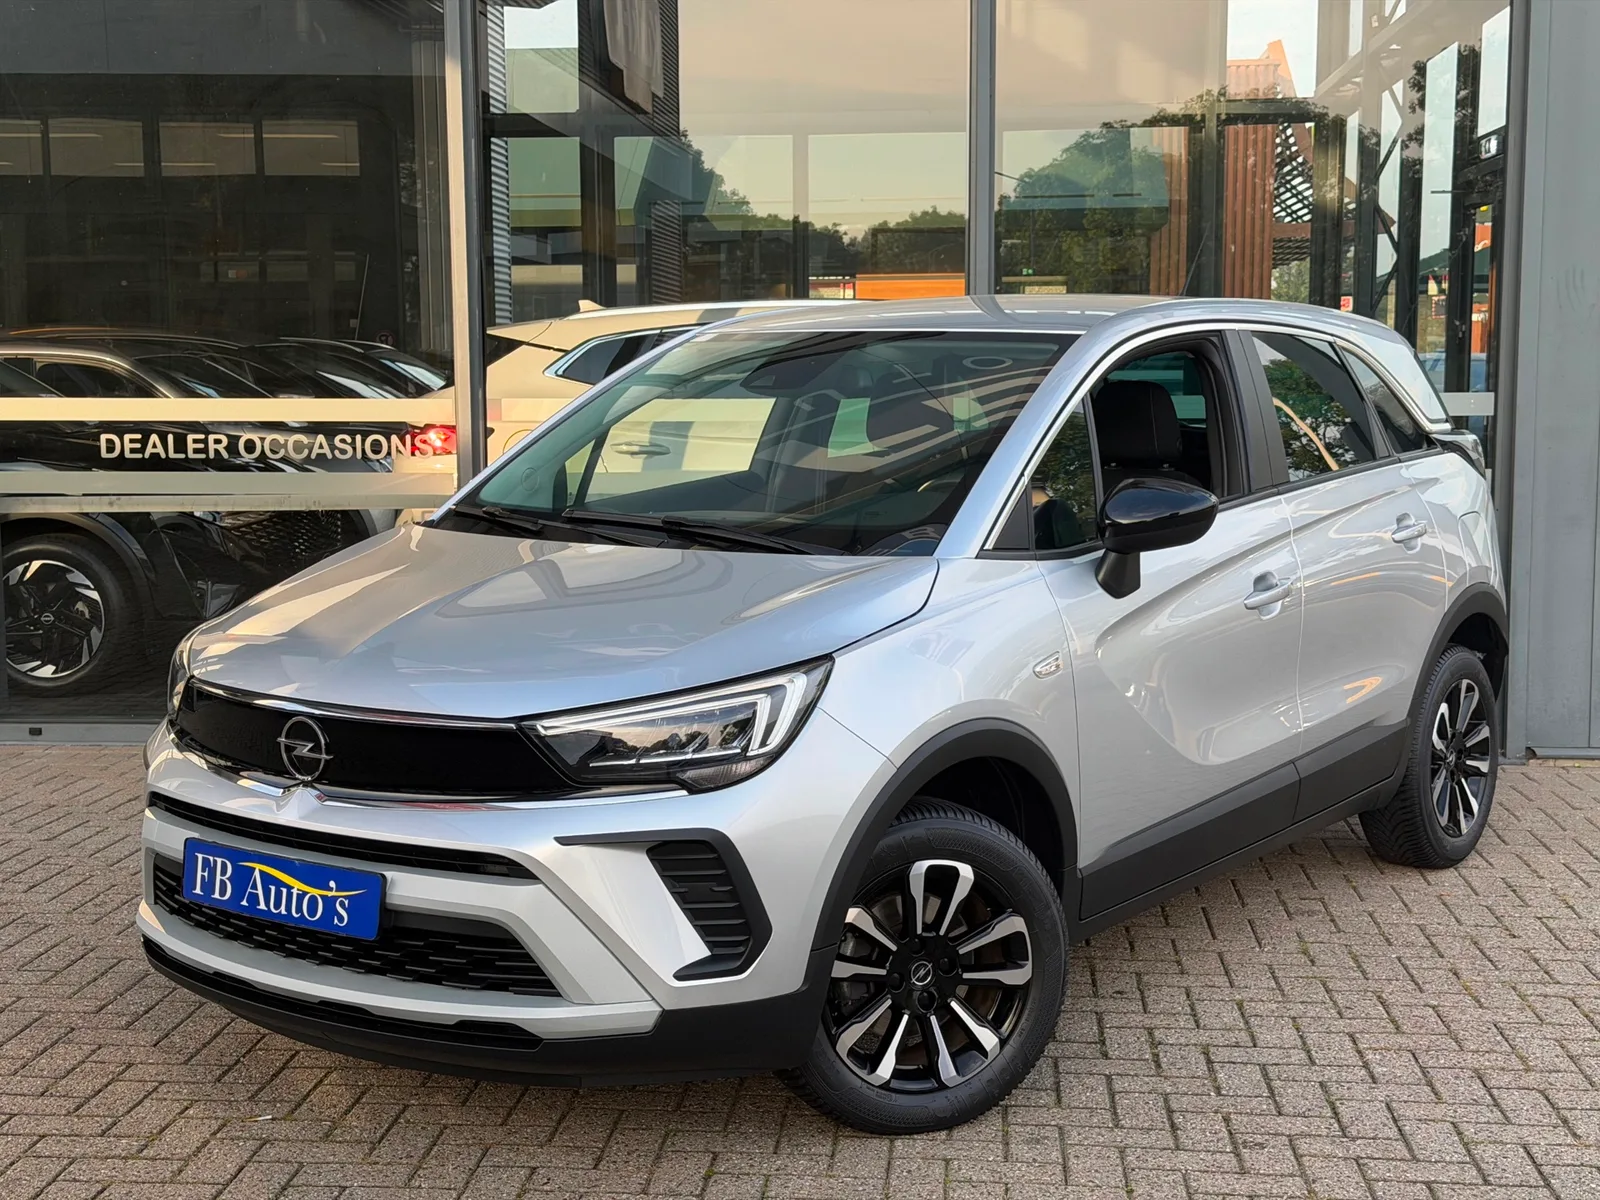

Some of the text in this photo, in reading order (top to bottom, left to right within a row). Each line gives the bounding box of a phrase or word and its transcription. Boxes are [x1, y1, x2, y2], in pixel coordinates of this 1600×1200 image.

[99, 433, 435, 460] DEALER OCCASIONS
[192, 852, 349, 927] FB Auto's
